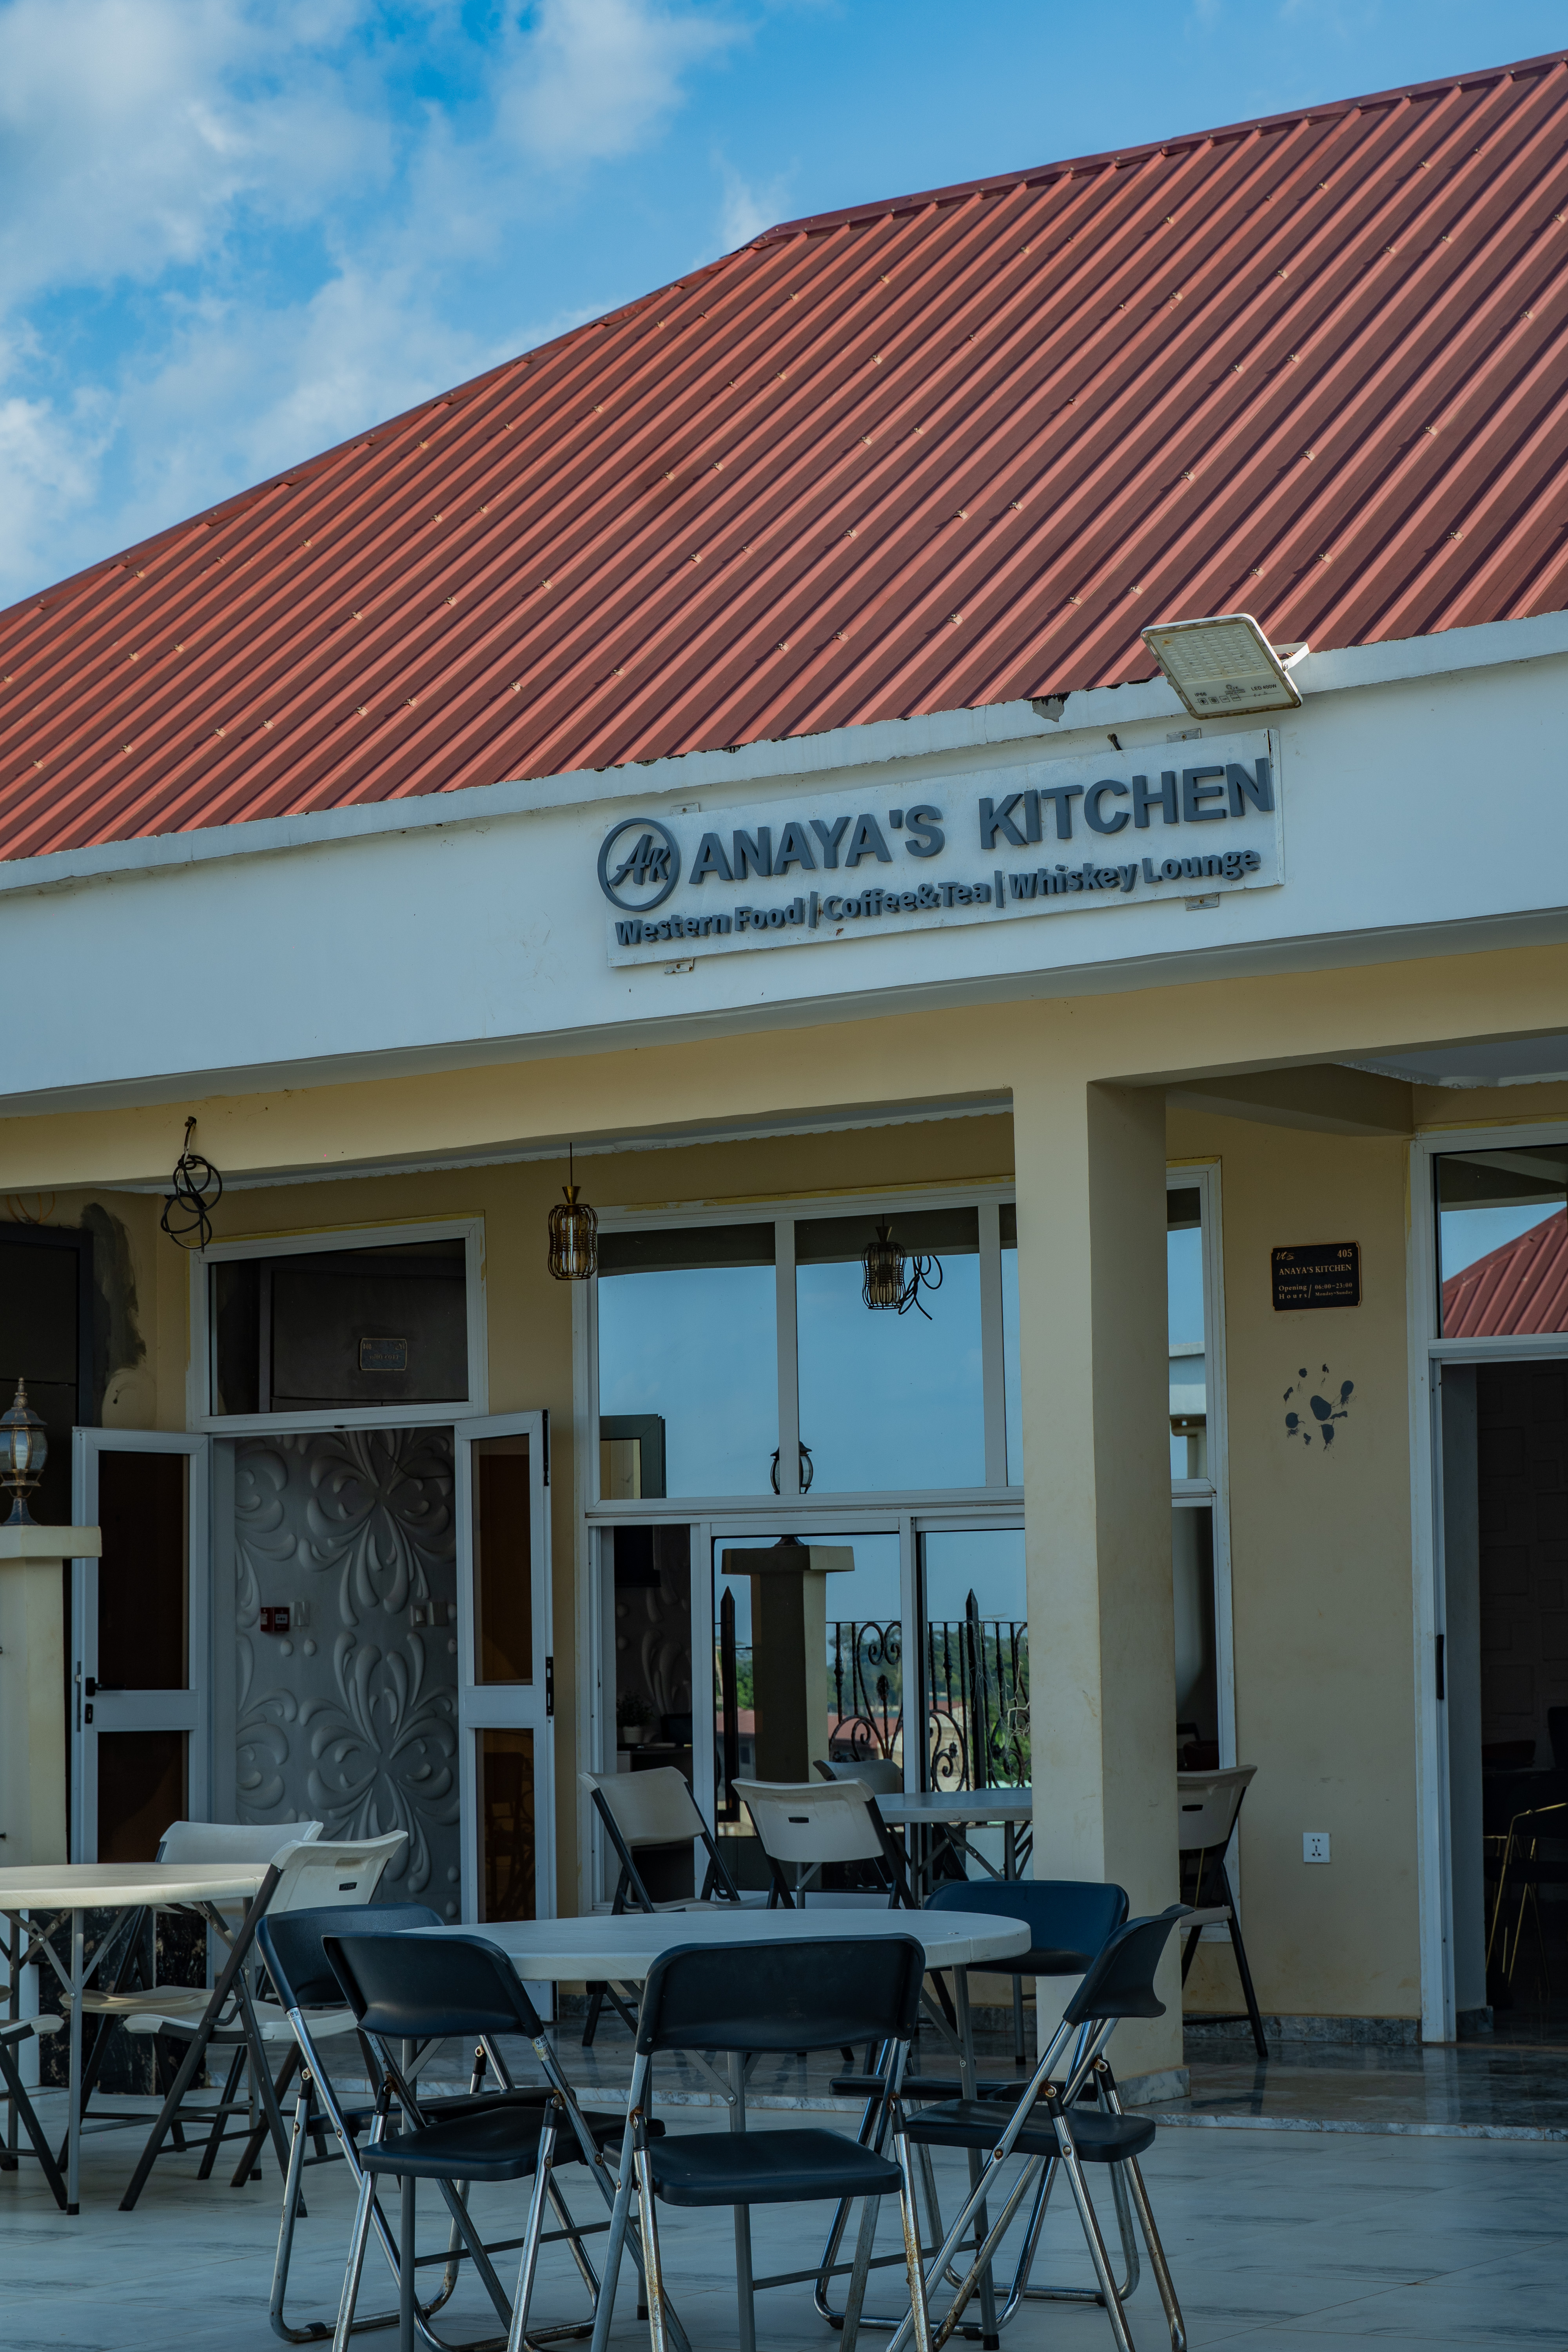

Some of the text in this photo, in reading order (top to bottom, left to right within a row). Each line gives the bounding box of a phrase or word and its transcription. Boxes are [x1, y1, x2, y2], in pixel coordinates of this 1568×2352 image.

[689, 758, 1273, 884] ANAYA'S KITCHEN
[615, 915, 731, 946] Western
[735, 897, 806, 931] Food
[823, 882, 991, 921] Coffee&Tea
[1008, 863, 1137, 899] Whiskey
[1142, 849, 1261, 881] Lounge
[1337, 1249, 1352, 1258] 405
[1279, 1264, 1352, 1275] ANAYA'S KITCHEN
[1279, 1284, 1307, 1292] Opening
